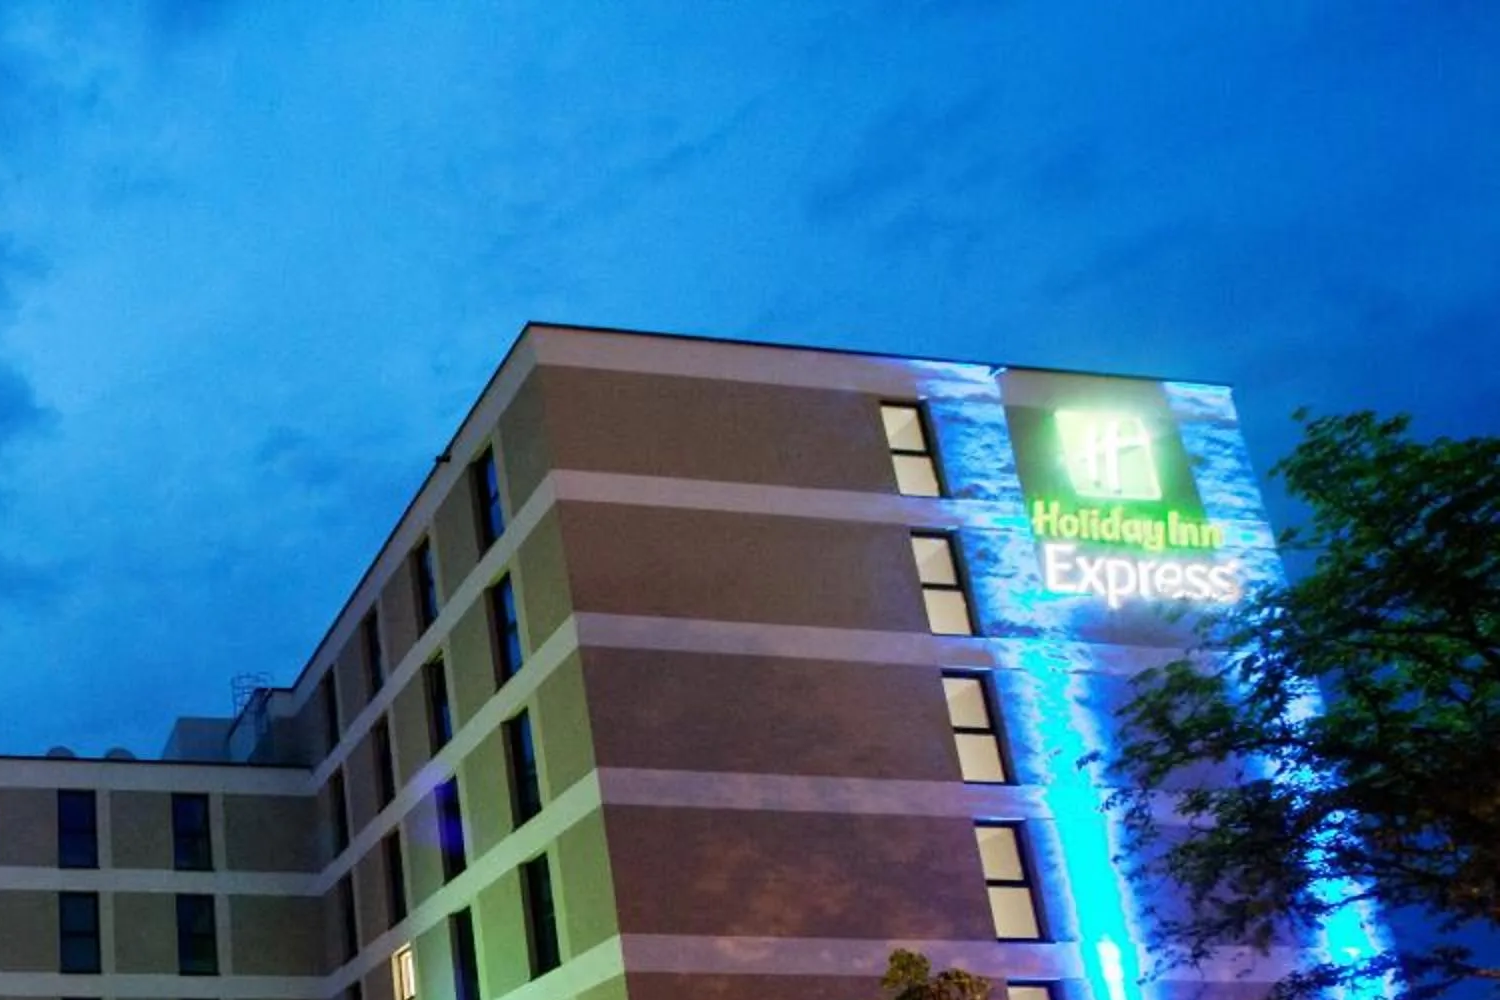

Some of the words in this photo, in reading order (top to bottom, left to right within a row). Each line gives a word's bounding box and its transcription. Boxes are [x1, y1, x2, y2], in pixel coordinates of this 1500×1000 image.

[1032, 500, 1166, 551] Holiday
[1167, 511, 1222, 547] Inn
[1044, 543, 1237, 610] Express
